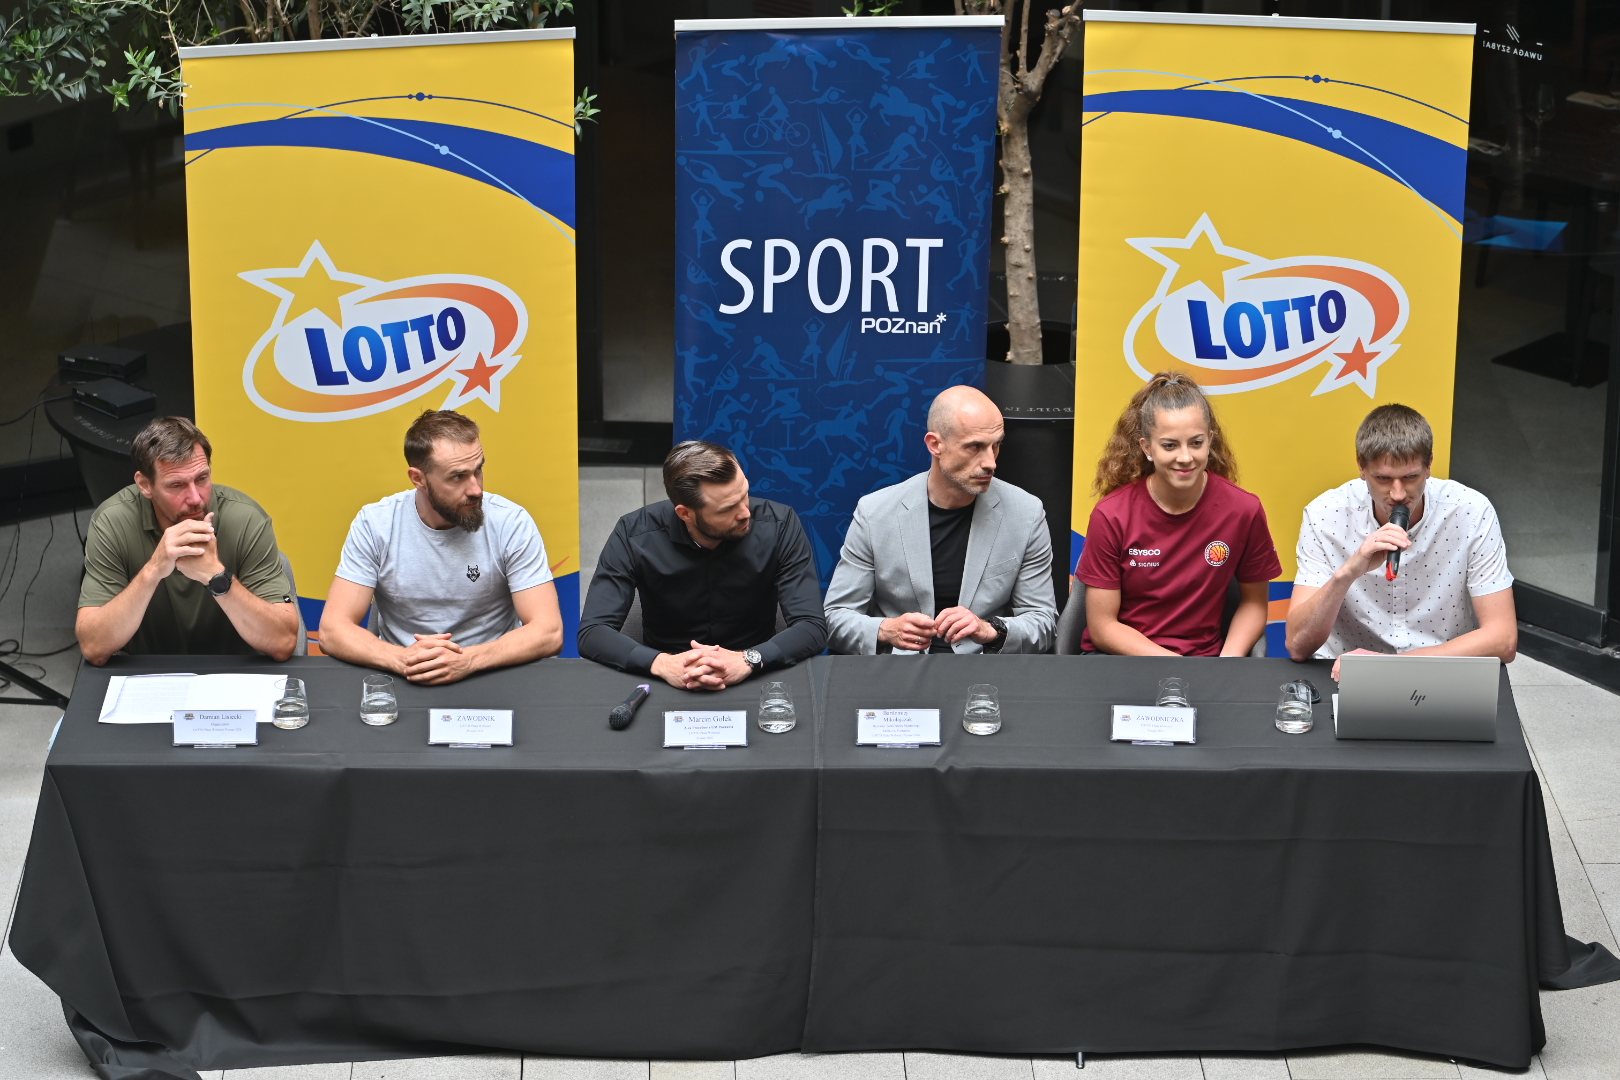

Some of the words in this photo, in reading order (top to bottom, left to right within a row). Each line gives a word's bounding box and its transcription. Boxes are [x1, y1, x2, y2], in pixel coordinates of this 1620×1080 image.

[718, 237, 944, 315] SPORT
[1187, 289, 1347, 360] LOTTO
[304, 306, 466, 386] LOTTO
[1128, 548, 1161, 556] ESYSCO
[688, 715, 712, 723] Marcin
[1136, 715, 1184, 723] ZAWODNICZKA
